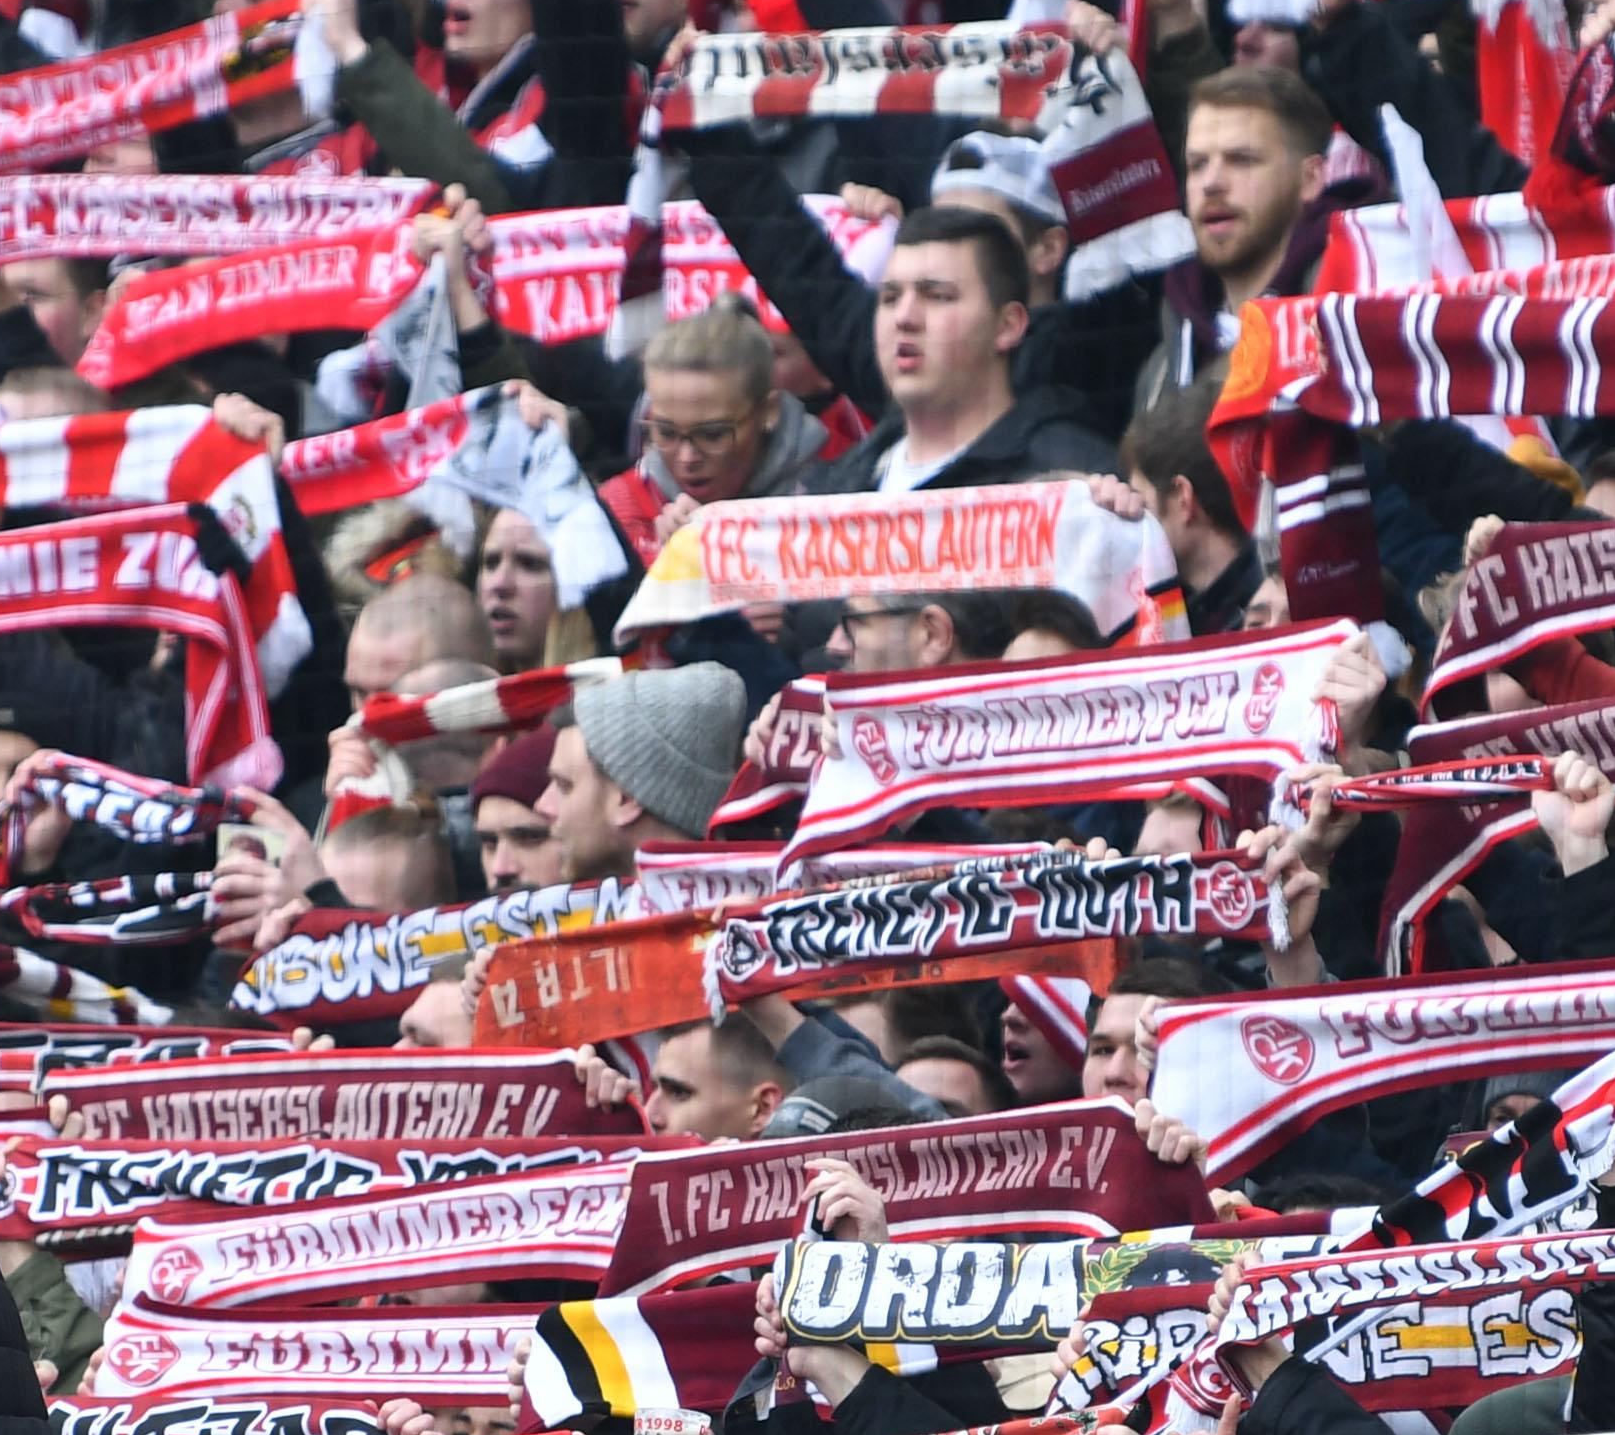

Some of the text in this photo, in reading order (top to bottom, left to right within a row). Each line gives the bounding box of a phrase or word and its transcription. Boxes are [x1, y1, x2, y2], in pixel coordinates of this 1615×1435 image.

[214, 245, 362, 312] ZIMMER
[777, 497, 1063, 581] KAISERSLAUTERN
[976, 688, 1144, 758] IMMER
[1136, 668, 1240, 744] FCK
[762, 852, 1202, 976] FRENETIC YOUTH
[325, 1190, 527, 1262] IMMER
[687, 1170, 736, 1234] FC
[1469, 1287, 1583, 1378] ES
